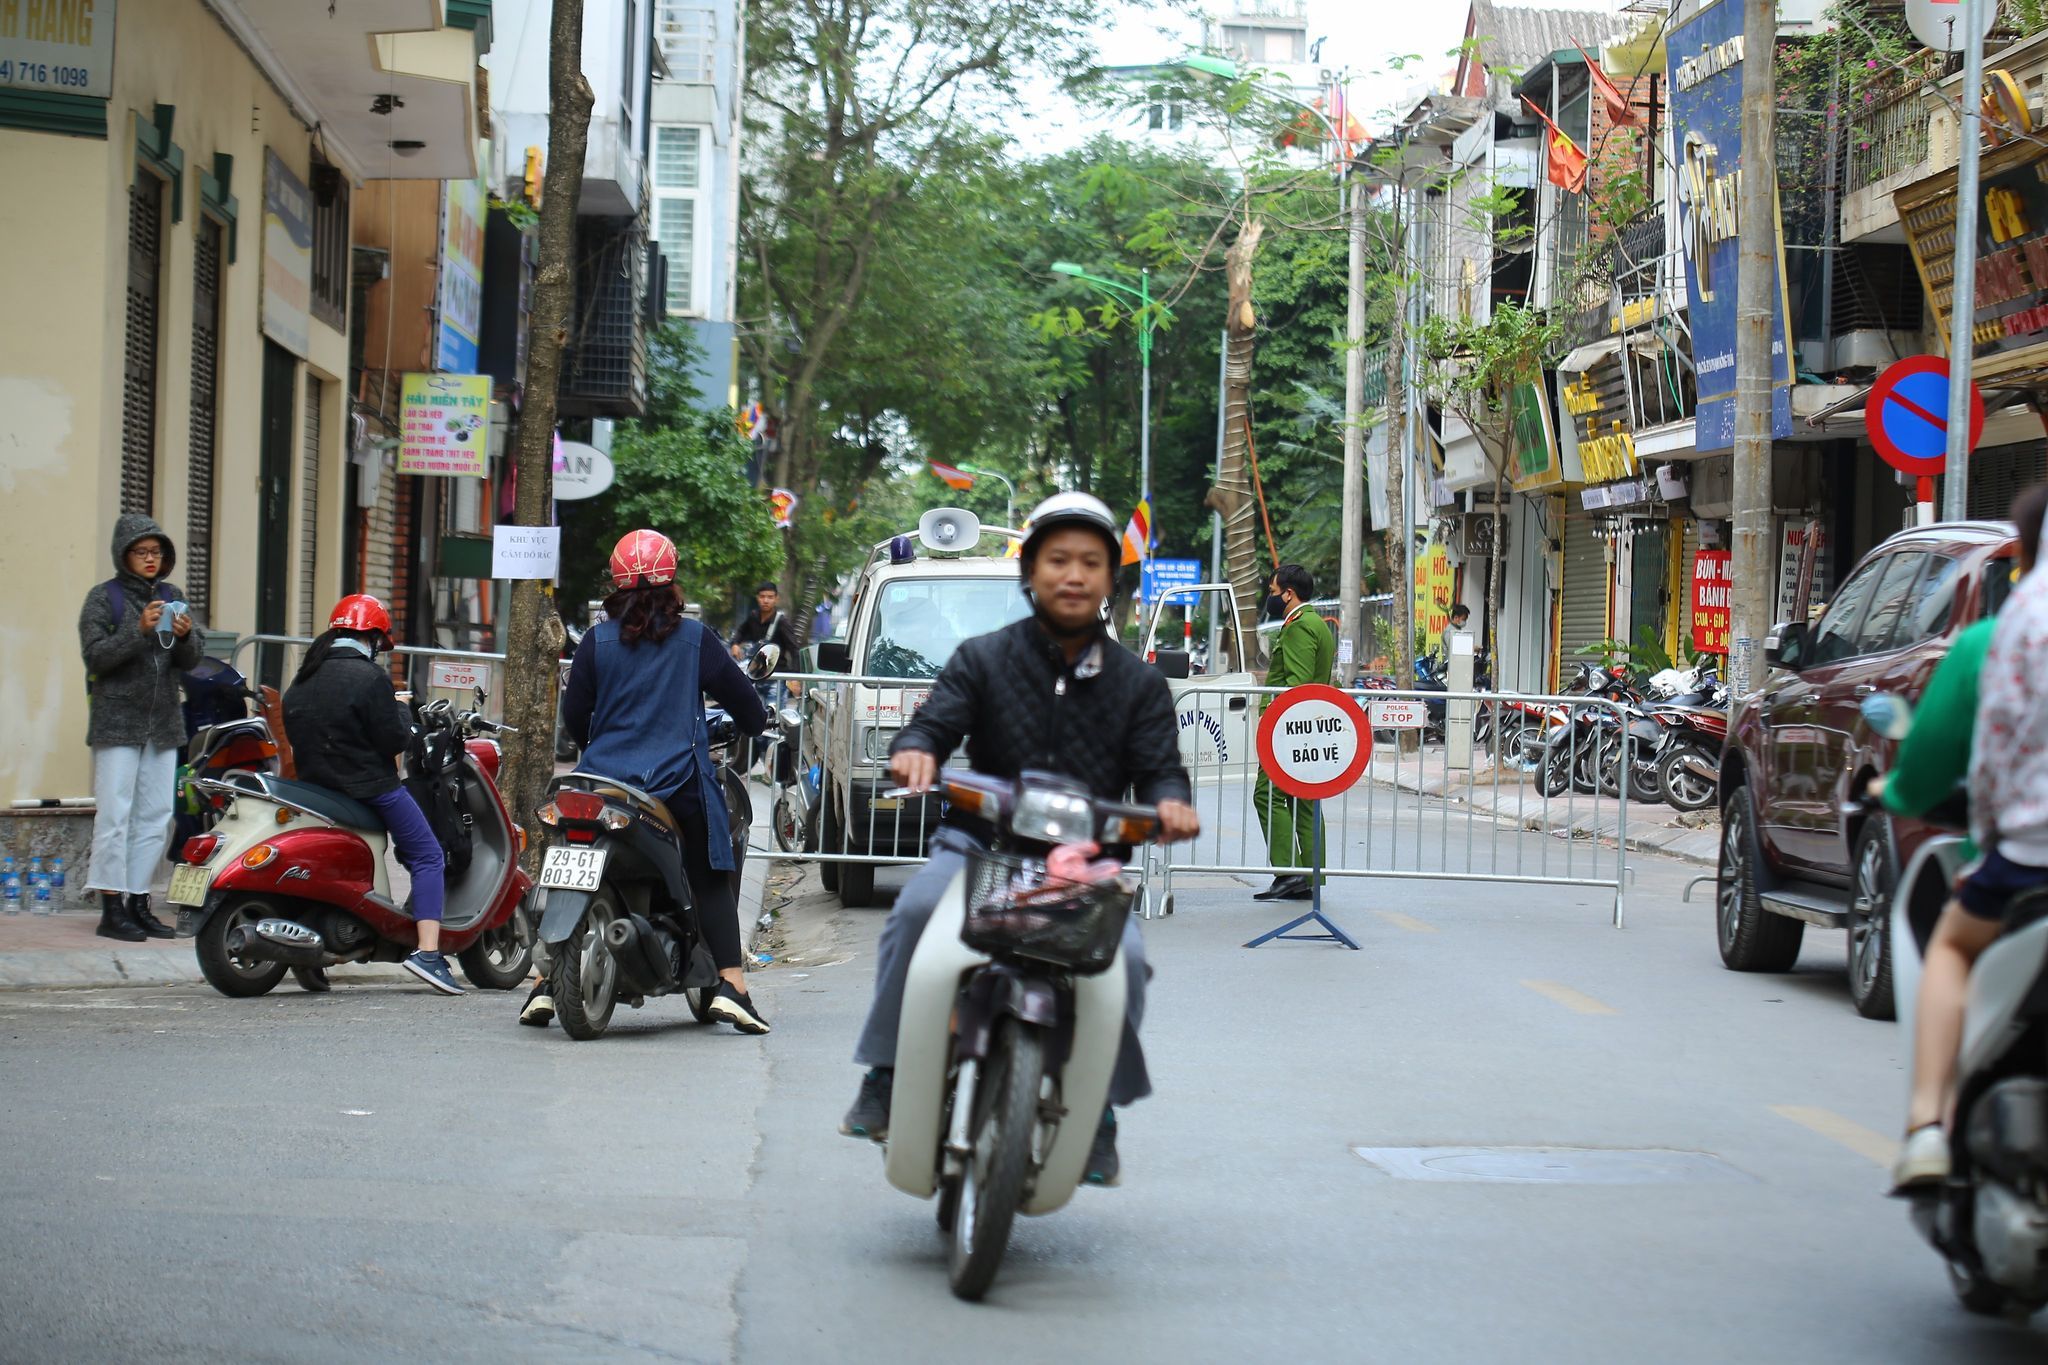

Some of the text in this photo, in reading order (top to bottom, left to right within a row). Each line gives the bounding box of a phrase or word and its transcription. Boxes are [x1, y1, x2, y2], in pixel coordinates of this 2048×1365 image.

[0, 59, 88, 87] 4) 716 1098
[509, 535, 528, 544] KHU
[1696, 555, 1716, 580] BÚN
[1699, 582, 1726, 608] BÁNH
[444, 674, 475, 685] STOP
[1180, 710, 1194, 729] AN
[1286, 717, 1342, 736] KHU VỰC
[1382, 713, 1414, 723] STOP
[1292, 743, 1339, 764] BẢO VỆ
[552, 850, 596, 869] 29-G1
[542, 867, 597, 888] 803.25
